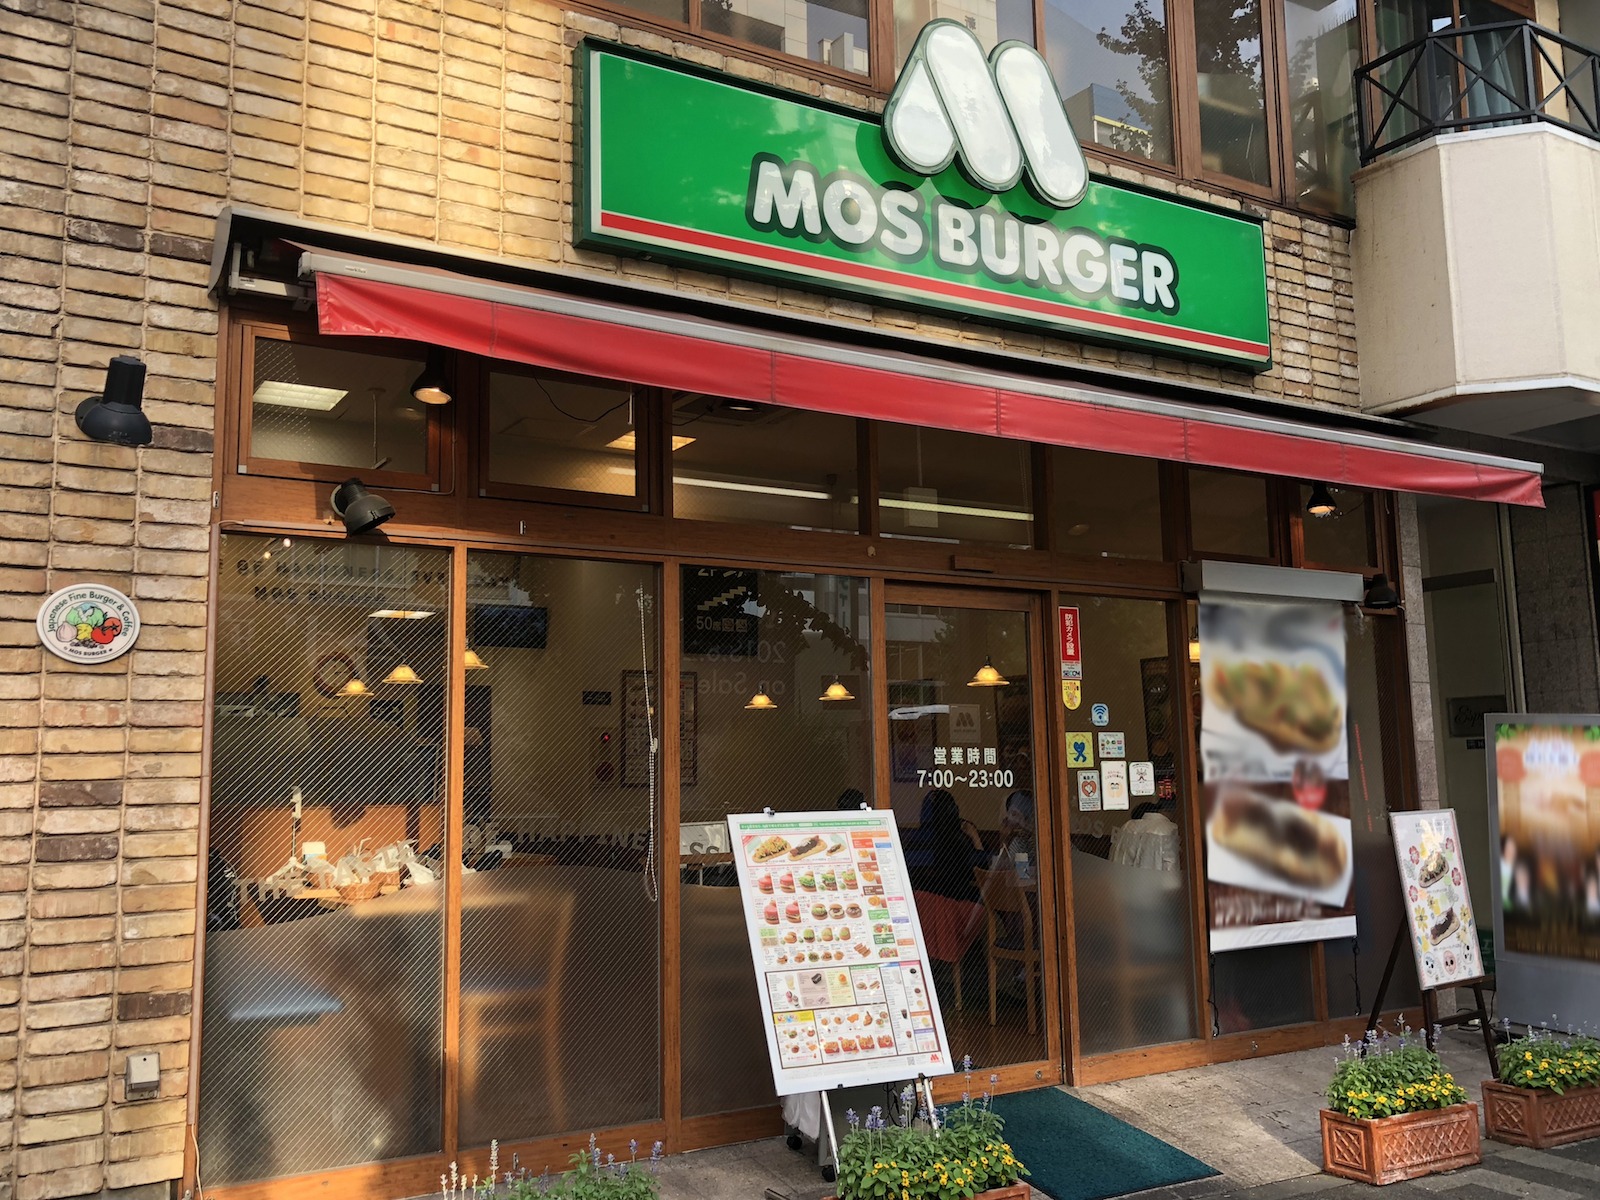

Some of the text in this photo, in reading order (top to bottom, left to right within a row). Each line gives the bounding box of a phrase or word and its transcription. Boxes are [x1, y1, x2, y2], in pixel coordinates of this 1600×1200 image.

[755, 161, 1177, 309] MOS BURGER
[48, 591, 133, 637] Japanese Fine Burger & Coffee
[68, 648, 108, 657] MOS BURGER
[933, 747, 997, 765] 営業時間
[916, 769, 1014, 788] 7:00~23:00
